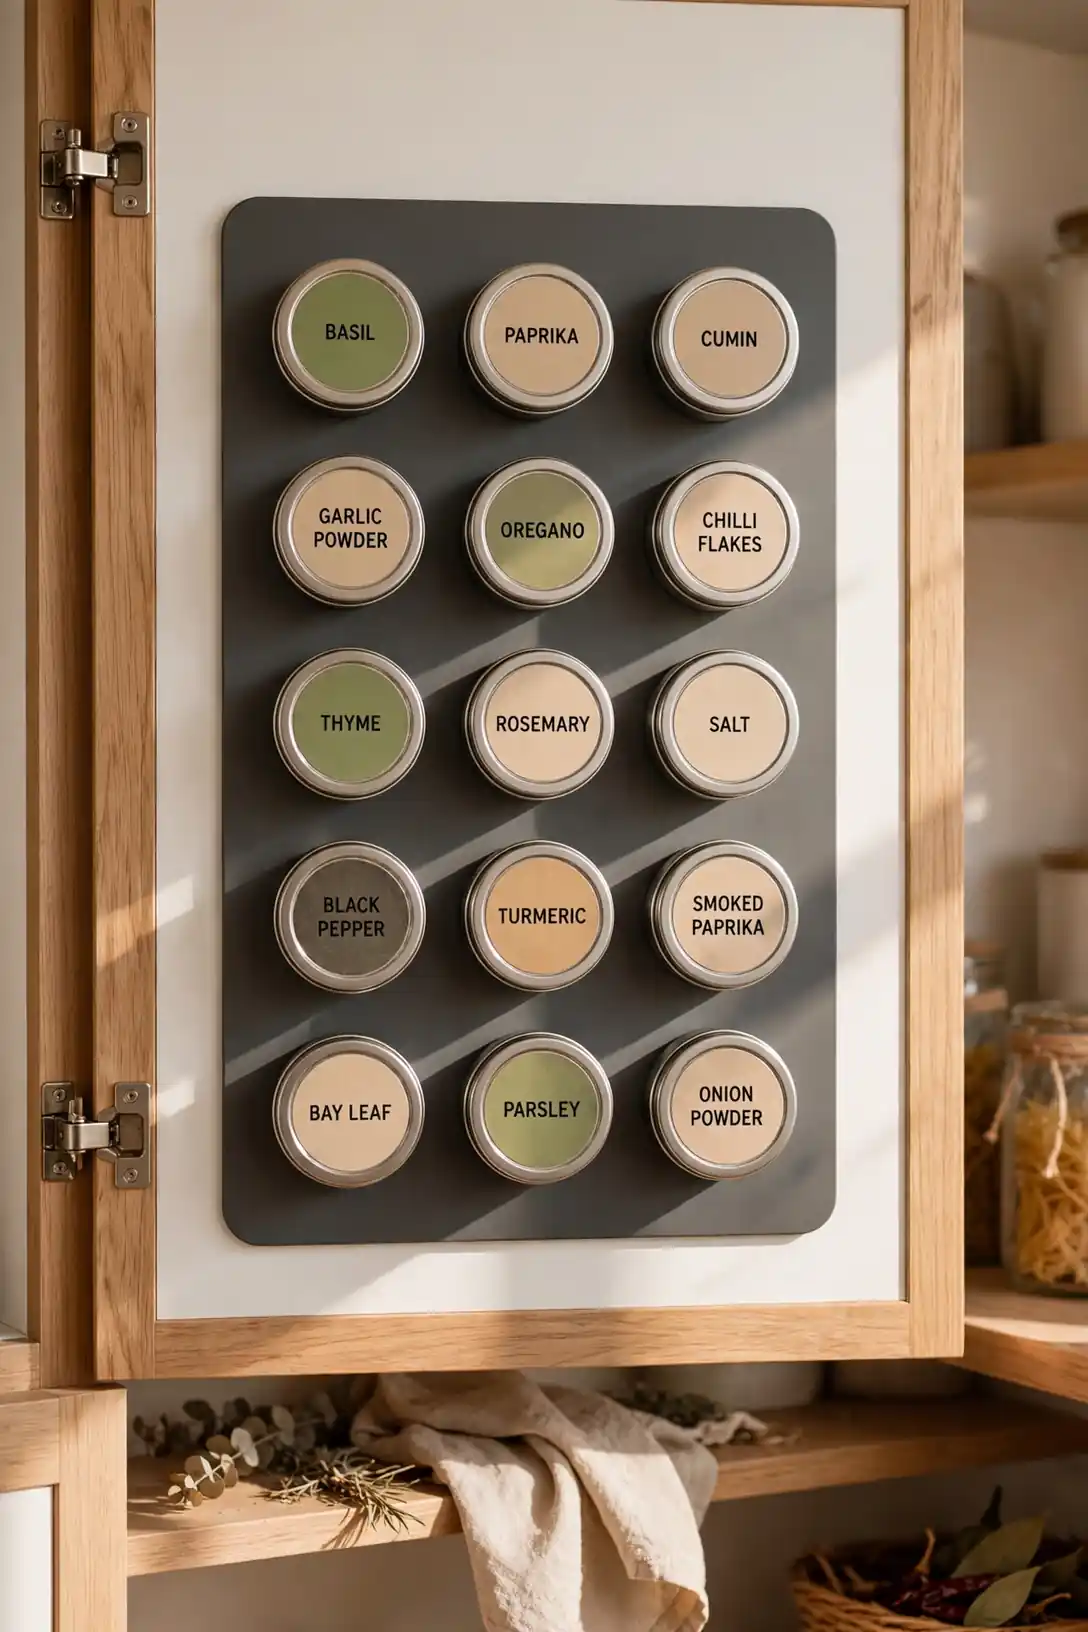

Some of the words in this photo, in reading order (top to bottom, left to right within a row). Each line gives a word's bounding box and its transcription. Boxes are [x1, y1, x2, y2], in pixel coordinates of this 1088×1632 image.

[325, 323, 375, 341] BASIL
[505, 326, 579, 344] PAPRIKA
[701, 330, 757, 348] CUMIN
[319, 507, 382, 525] GARLIC
[702, 511, 757, 529] CHILLI
[500, 521, 585, 539] OREGANO
[314, 531, 388, 549] POWDER
[698, 535, 762, 553] FLAKES
[320, 714, 381, 732] THYME
[496, 715, 590, 733] ROSEMARY
[709, 716, 750, 733] SALT
[323, 896, 380, 914] BLACK
[693, 895, 764, 912] SMOKED
[498, 907, 586, 925] TURMERIC
[318, 920, 385, 937] PEPPER
[692, 918, 765, 936] PAPRIKA
[699, 1085, 753, 1103] ONION
[309, 1104, 343, 1121] BAY
[349, 1104, 392, 1121] LEAF
[504, 1100, 580, 1118] PARSLEY
[691, 1109, 763, 1127] POWDER
